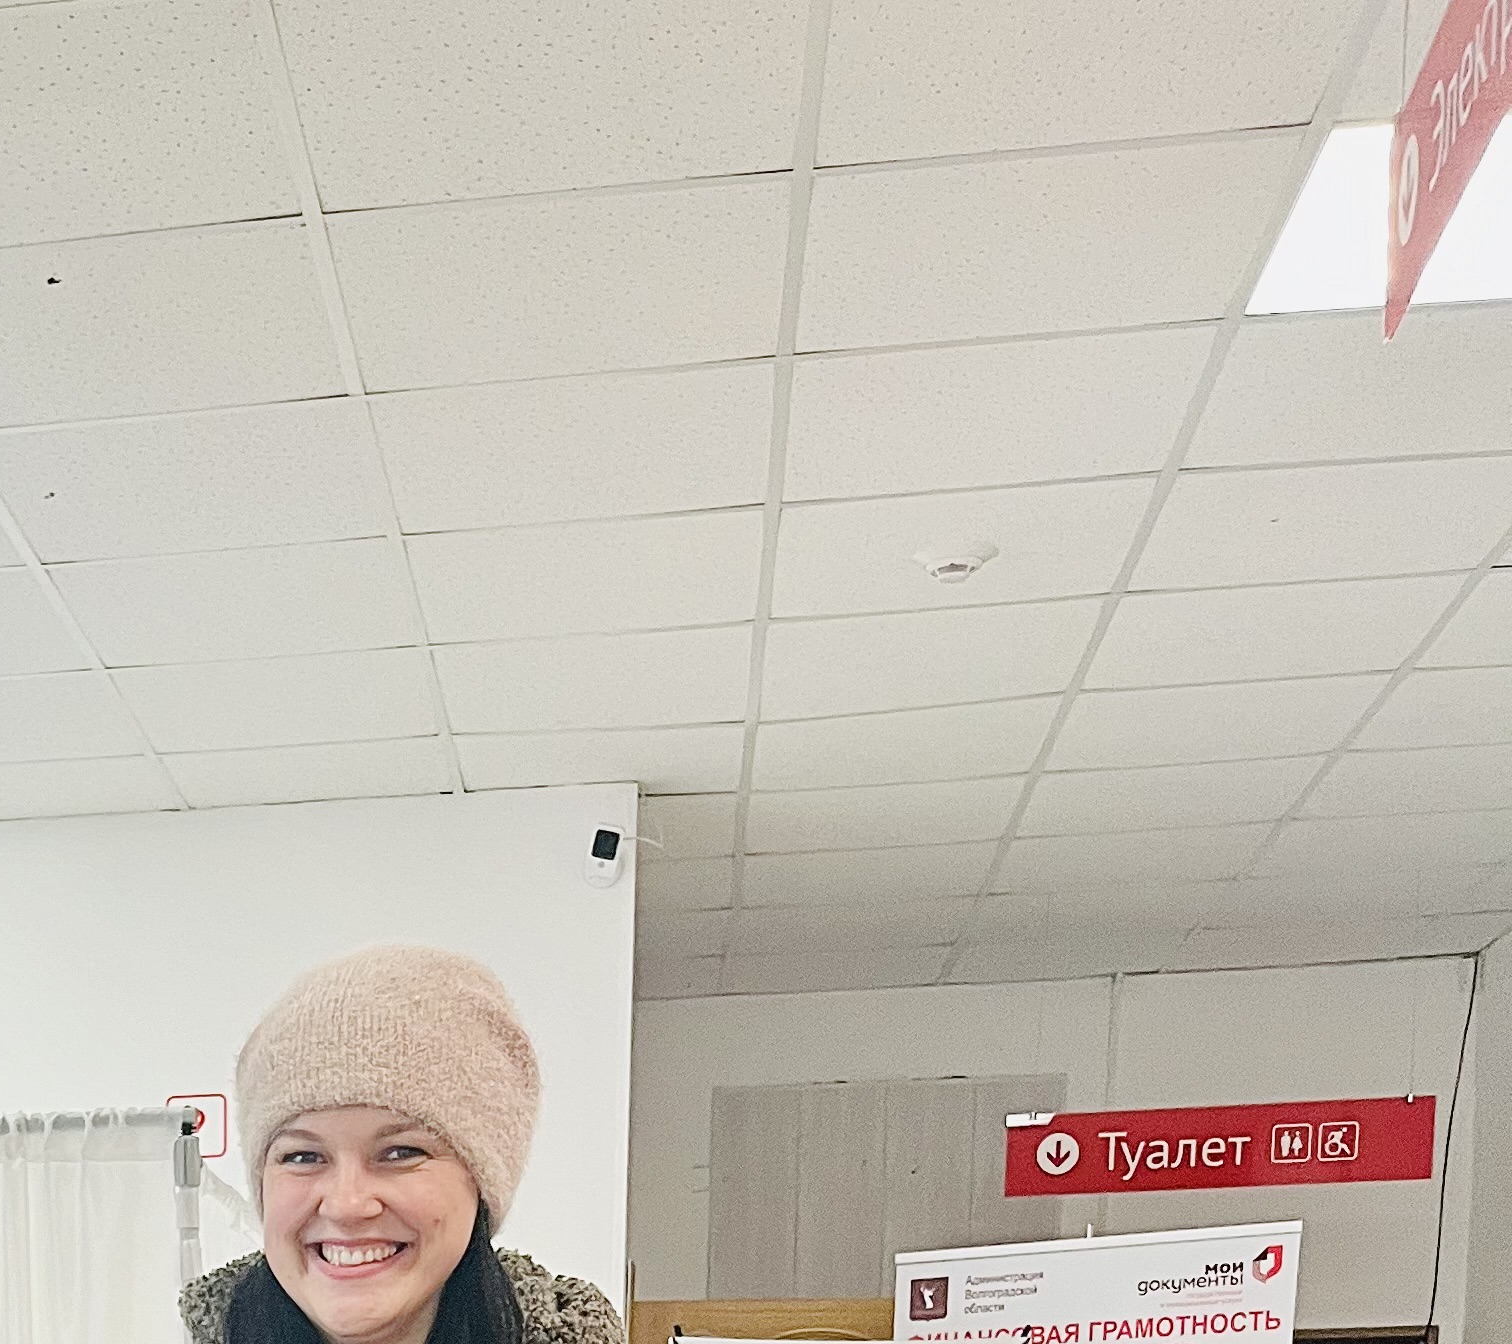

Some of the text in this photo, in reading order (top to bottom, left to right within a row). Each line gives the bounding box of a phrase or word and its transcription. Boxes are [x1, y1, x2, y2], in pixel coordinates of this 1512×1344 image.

[1097, 1131, 1252, 1181] Туалет
[1204, 1261, 1244, 1275] мои
[1137, 1273, 1244, 1296] документы
[964, 1302, 1005, 1315] области
[1088, 1309, 1282, 1342] ГРАМОТНОСТЬ
